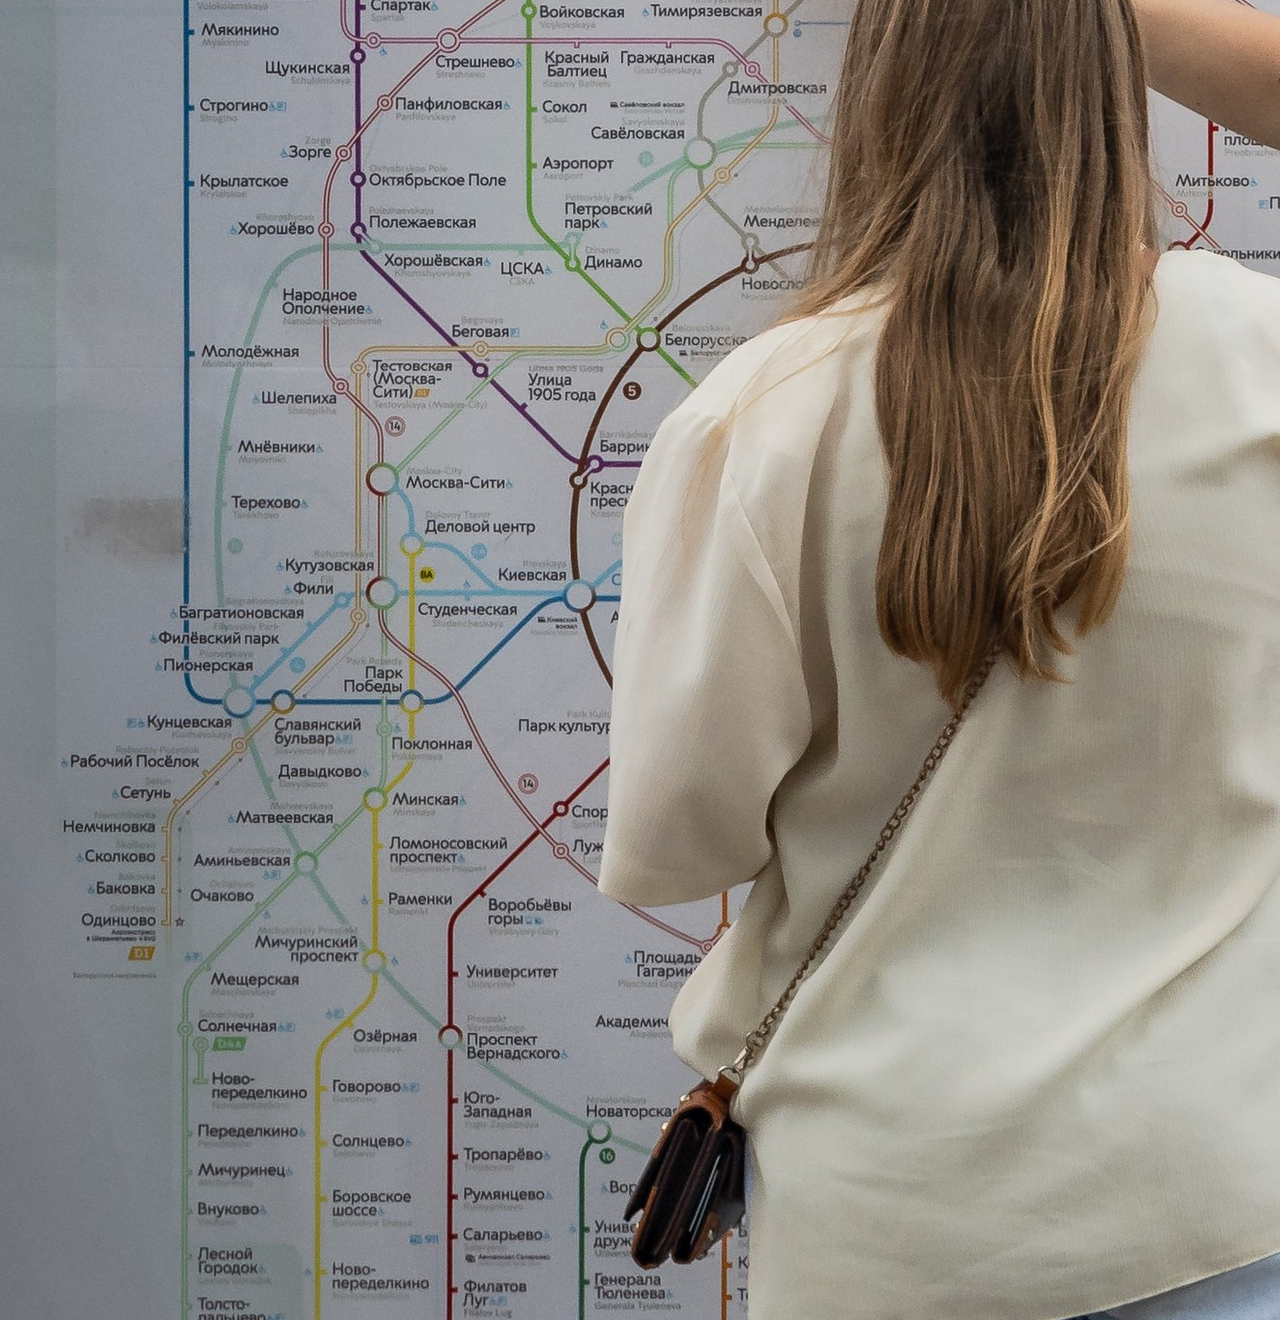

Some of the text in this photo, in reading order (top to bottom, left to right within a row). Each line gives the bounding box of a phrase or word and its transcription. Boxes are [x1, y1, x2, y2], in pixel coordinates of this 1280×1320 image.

[539, 5, 625, 19] Войковская
[650, 5, 763, 19] Тимирязевская
[727, 81, 827, 96] Дмитровская
[200, 99, 269, 114] Строгино
[591, 126, 685, 141] Савёловская
[200, 175, 289, 189] Крылатское
[369, 174, 506, 189] Октябрьское Поле
[1175, 174, 1250, 188] Митьково
[500, 262, 544, 278] ЦСКА
[584, 256, 643, 271] Динамо
[451, 326, 510, 339] Беговая
[201, 344, 300, 360] Молодёжная
[528, 374, 572, 388] Улица
[528, 388, 596, 403] 1905 года
[389, 421, 401, 432] 14
[405, 476, 506, 490] Москва-Сити
[424, 520, 536, 535] Деловой центр
[285, 559, 375, 574] Кутузовская
[498, 568, 567, 581] Киевская
[418, 603, 517, 617] Студенческая
[163, 659, 253, 675] Пионерская
[391, 738, 473, 751] Поклонная
[70, 754, 200, 769] Рабочий Посёлок
[278, 765, 362, 779] Давыдково
[392, 793, 459, 806] Минская
[63, 820, 156, 834] Немчиновка
[488, 898, 572, 912] Воробьёвы
[488, 914, 524, 927] горы
[466, 965, 558, 980] Университет
[210, 973, 300, 988] Мещерская
[466, 1033, 538, 1048] Проспект
[466, 1047, 560, 1062] Вернадского
[197, 1124, 298, 1139] Переделкино
[332, 1134, 405, 1149] Солнцево
[463, 1228, 543, 1244] Саларьево
[594, 1273, 661, 1287] Генерала
[594, 1287, 666, 1300] Тюленева
